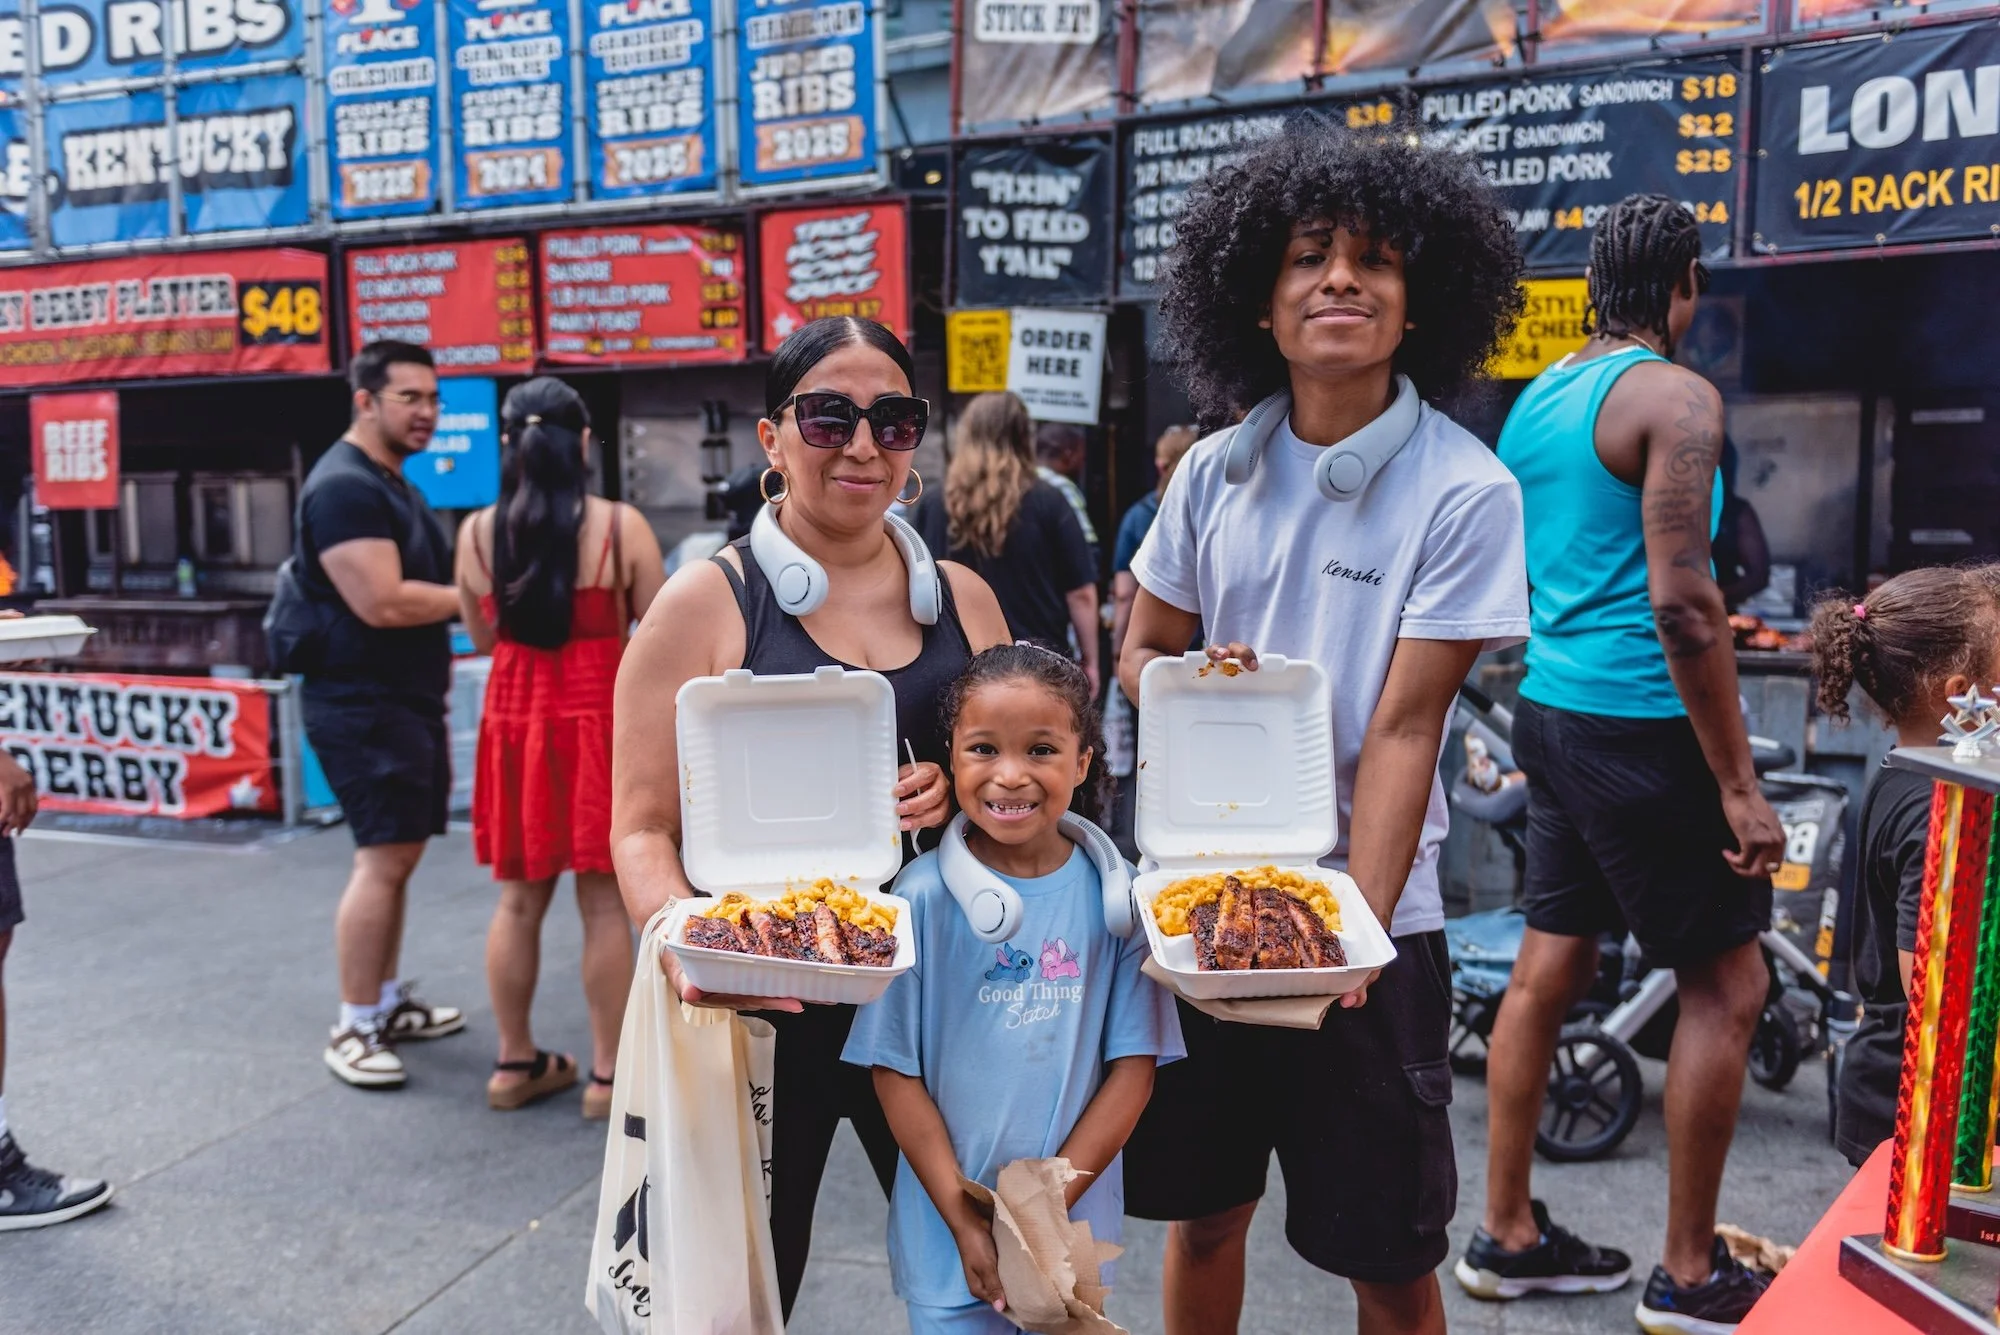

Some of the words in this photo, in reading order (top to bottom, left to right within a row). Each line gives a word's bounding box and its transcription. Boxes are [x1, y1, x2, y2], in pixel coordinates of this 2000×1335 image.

[108, 0, 286, 60] RIBS
[753, 69, 855, 121] RIBS
[1508, 83, 1574, 115] PORK
[1578, 78, 1674, 108] SANDWICH
[1681, 73, 1738, 101] $18
[1798, 64, 2000, 155] LON
[773, 121, 850, 163] 2025
[1513, 120, 1605, 150] SANDWICH
[1678, 112, 1734, 138] $22
[1547, 151, 1613, 182] PORK
[1675, 148, 1733, 175] $25
[1794, 178, 1842, 219] 1/2
[1850, 167, 1955, 215] RACK
[1963, 163, 2000, 204] RI
[962, 206, 1010, 240] TO
[1012, 207, 1091, 243] FEED
[242, 285, 321, 337] $48
[1020, 328, 1092, 352] ORDER
[1027, 355, 1081, 378] HERE
[43, 419, 109, 451] BEEF
[46, 448, 109, 483] RIBS
[1321, 559, 1385, 586] Kenshi
[978, 983, 1025, 1004] Good
[1005, 1001, 1062, 1030] Stitch
